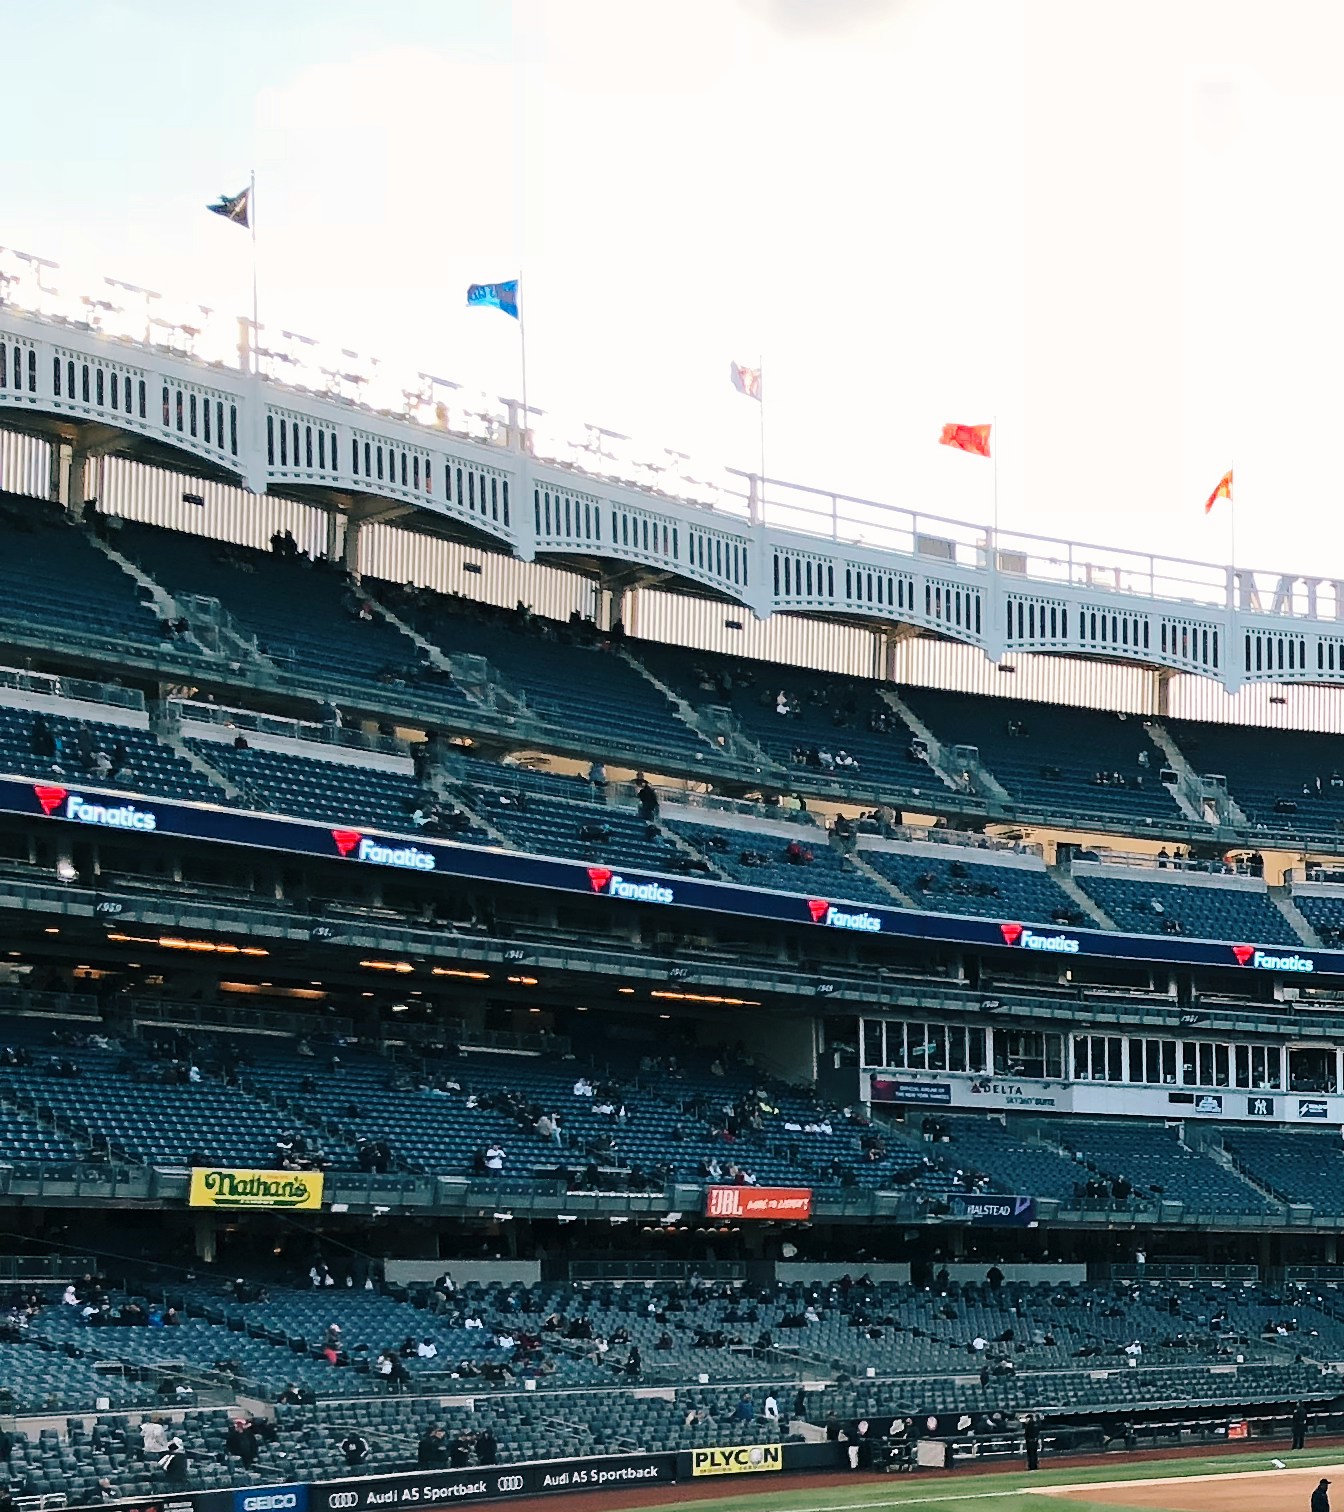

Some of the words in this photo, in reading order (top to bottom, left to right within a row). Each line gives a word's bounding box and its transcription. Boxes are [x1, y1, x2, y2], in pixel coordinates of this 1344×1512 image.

[66, 796, 156, 830] Fanatics
[359, 837, 436, 871] Fanatics
[610, 876, 674, 903] Fanatics
[826, 907, 882, 931] Fanatics
[1021, 930, 1080, 953] Fanatics
[1253, 951, 1314, 972] Fanatics
[983, 1084, 1022, 1095] DELTA
[204, 1171, 308, 1198] Nathan's
[710, 1189, 743, 1216] JBL
[967, 1204, 1011, 1216] HALSTEAD
[543, 1472, 569, 1487] Audi
[572, 1471, 588, 1484] A5
[590, 1465, 658, 1484] Sportback
[243, 1493, 297, 1512] GEICO
[366, 1490, 398, 1505] Audi
[401, 1487, 419, 1501] A5
[423, 1480, 487, 1501] Sportback
